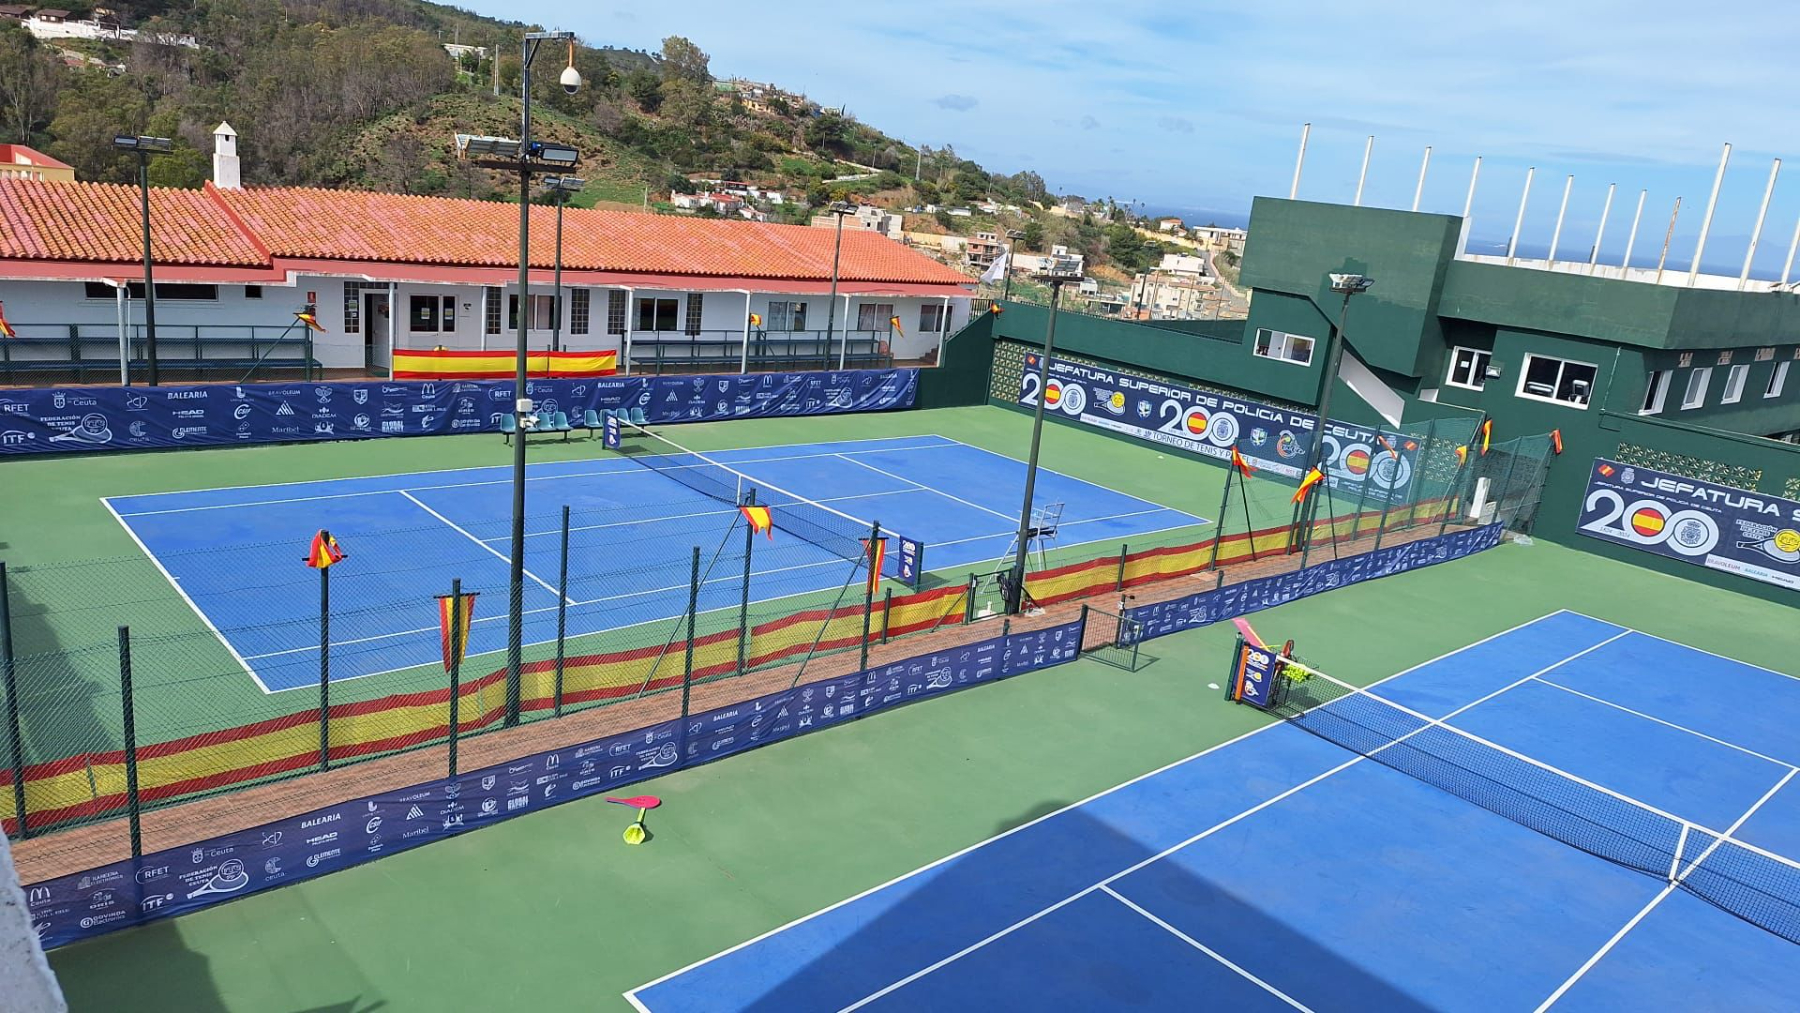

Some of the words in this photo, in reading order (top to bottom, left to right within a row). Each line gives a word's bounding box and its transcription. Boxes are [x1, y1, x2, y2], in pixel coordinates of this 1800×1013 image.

[598, 381, 625, 391] BALEARIA
[167, 390, 208, 400] BALEARIA
[494, 390, 512, 398] RFET
[4, 403, 30, 413] RFET
[73, 398, 98, 407] Ceuta
[1049, 363, 1115, 385] JEFATURA
[1119, 378, 1192, 402] SUPERIOR
[1195, 395, 1218, 408] DE
[1289, 415, 1316, 431] DE
[1324, 424, 1381, 445] CEUTA
[1157, 400, 1239, 448] 200
[2, 434, 26, 445] ITF
[1153, 430, 1183, 447] TORNEO
[1184, 438, 1195, 449] DE
[1196, 440, 1218, 457] TENIS
[1219, 447, 1224, 456] Y
[1641, 477, 1780, 517] JEFATURA
[1580, 489, 1720, 556] 200
[610, 767, 625, 779] ITF
[301, 812, 342, 829] BALEARIA
[306, 832, 338, 844] HEAD
[210, 847, 235, 858] Ceuta
[144, 865, 170, 879] RFET
[142, 897, 166, 912] ITF
